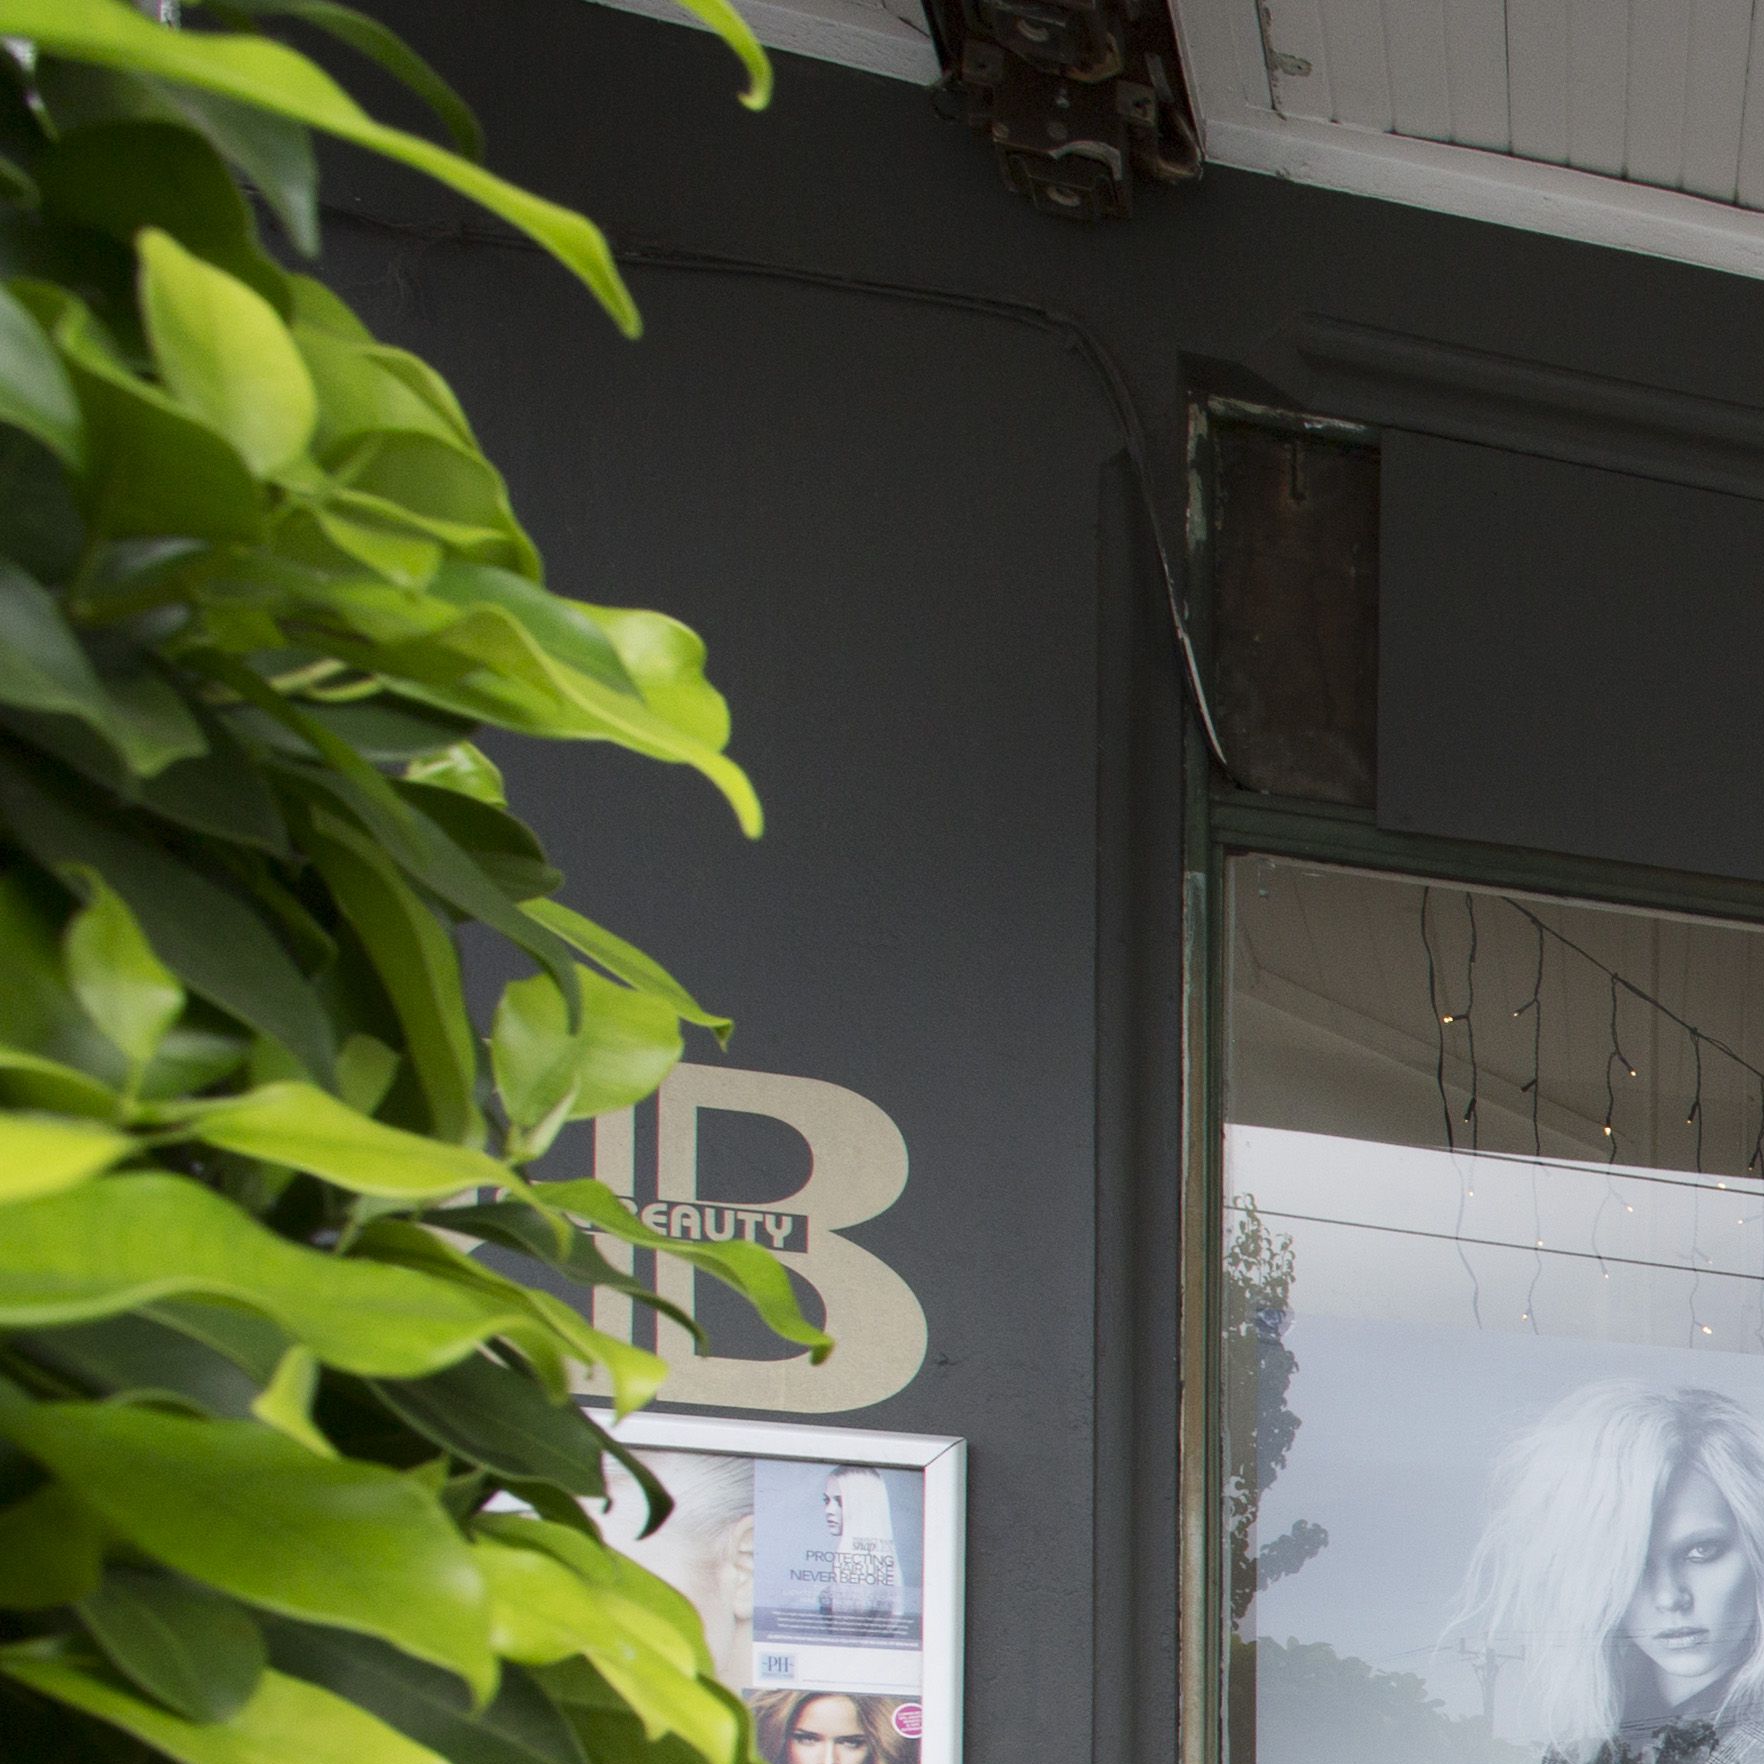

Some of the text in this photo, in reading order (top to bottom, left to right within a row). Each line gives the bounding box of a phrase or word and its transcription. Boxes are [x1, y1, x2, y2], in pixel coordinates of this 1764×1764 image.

[806, 1550, 895, 1567] PROTECTING
[790, 1569, 895, 1587] NEVER BEFORE
